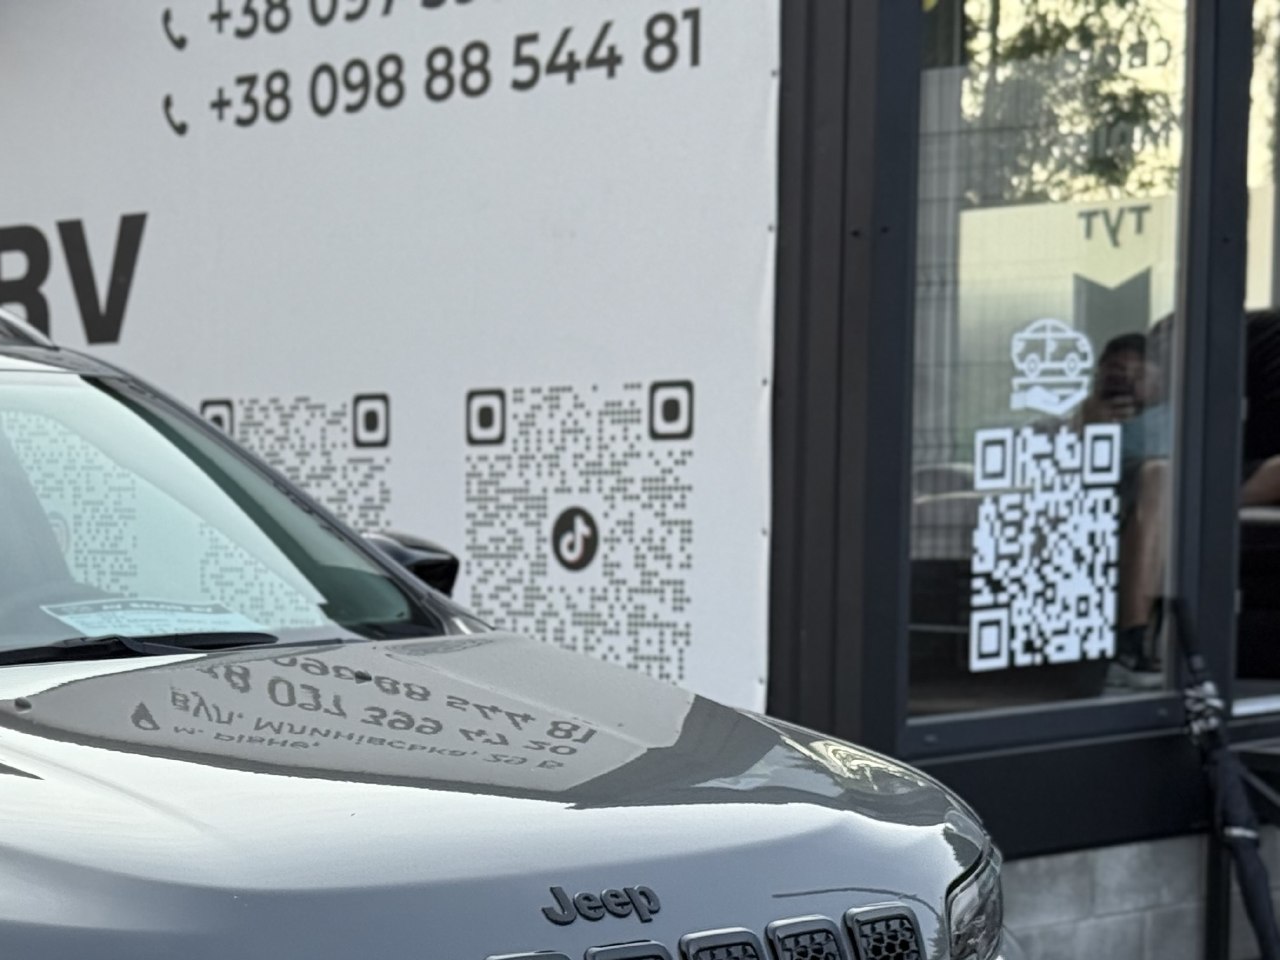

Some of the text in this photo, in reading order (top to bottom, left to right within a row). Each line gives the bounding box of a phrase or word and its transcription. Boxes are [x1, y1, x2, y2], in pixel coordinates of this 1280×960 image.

[209, 8, 701, 127] +38 098 88 544 81
[540, 883, 661, 927] Jeep
